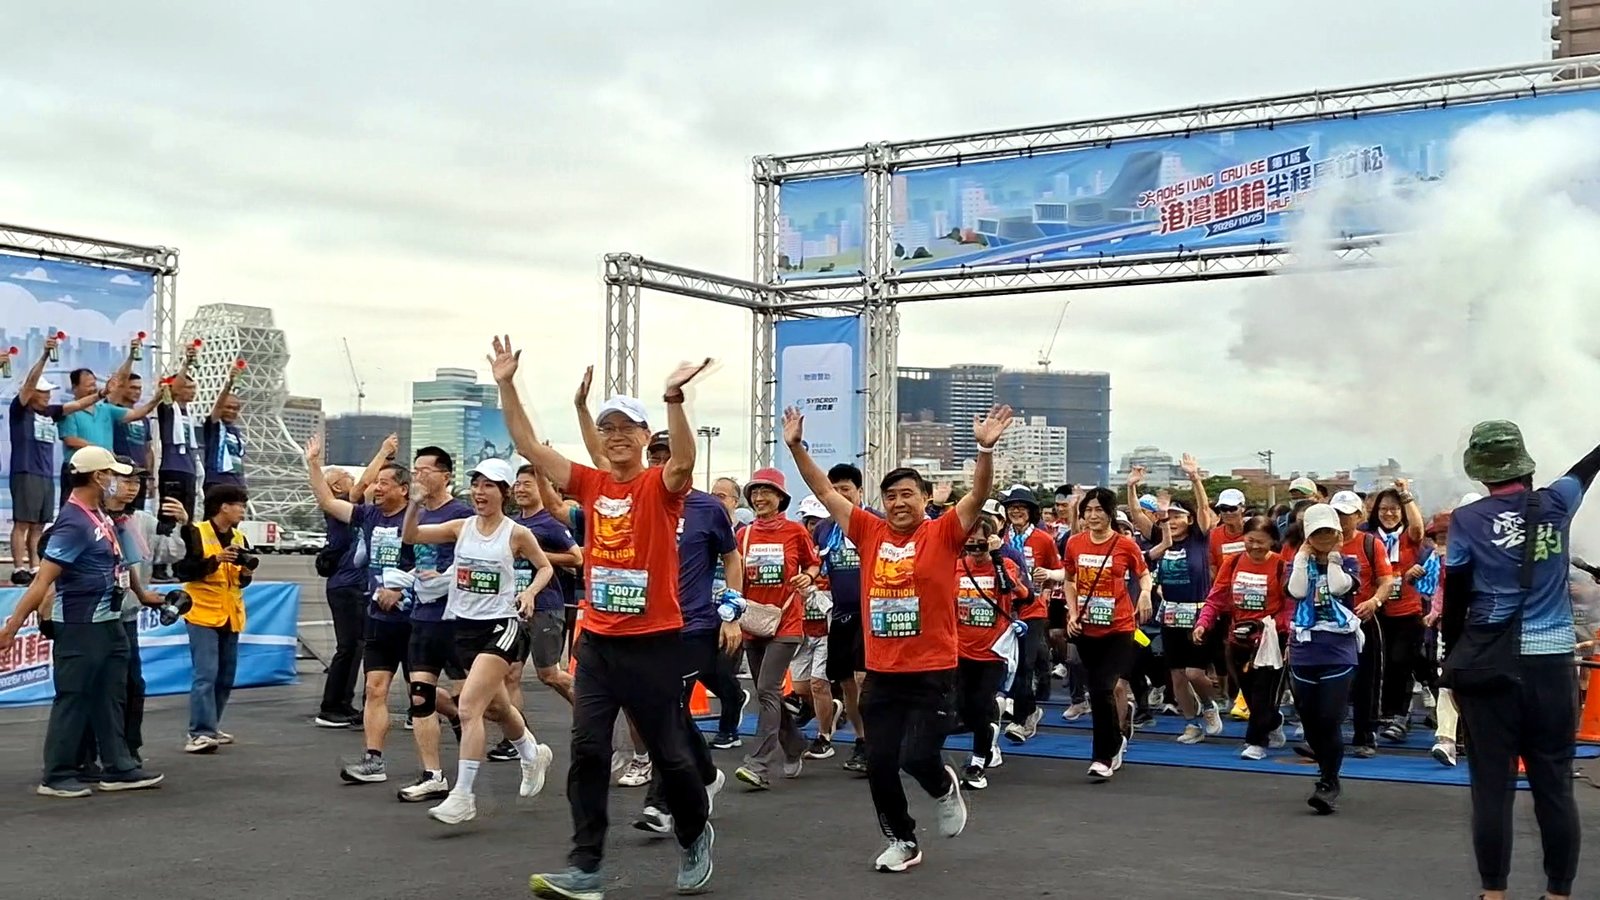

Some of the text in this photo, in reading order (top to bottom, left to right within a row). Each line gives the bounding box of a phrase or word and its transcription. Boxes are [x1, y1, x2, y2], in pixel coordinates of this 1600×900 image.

[1221, 161, 1265, 182] CRUISE
[1160, 179, 1265, 234] 港灣郵輪
[1267, 196, 1290, 211] HALF
[1212, 212, 1263, 233] 2026/10/25
[470, 571, 497, 581] 60961
[759, 565, 782, 573] 60761
[608, 585, 643, 597] 50077
[886, 613, 917, 623] 50088
[0, 667, 48, 687] 026/10/25
